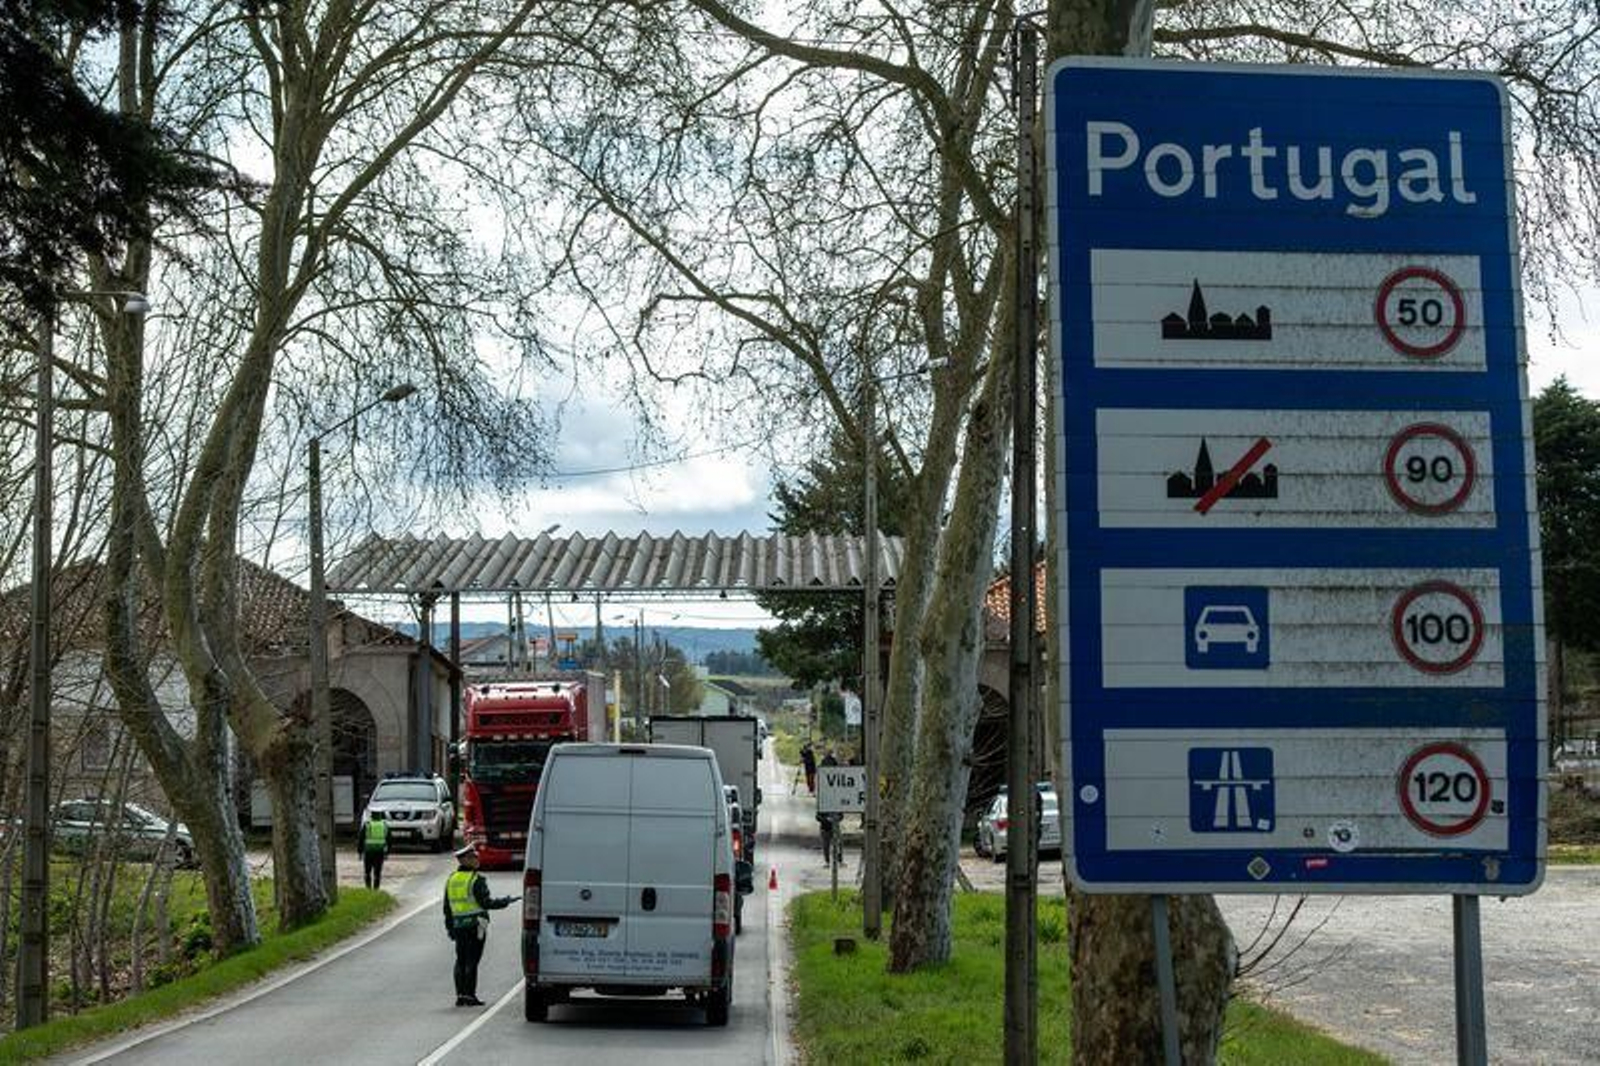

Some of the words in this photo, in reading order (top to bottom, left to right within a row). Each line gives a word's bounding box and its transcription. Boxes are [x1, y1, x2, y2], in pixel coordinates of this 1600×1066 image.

[1086, 121, 1477, 219] Portugal
[1398, 299, 1442, 326] 50
[1407, 456, 1452, 483] 90
[1407, 614, 1469, 644] 100
[827, 773, 854, 787] Vila
[1415, 772, 1476, 802] 120
